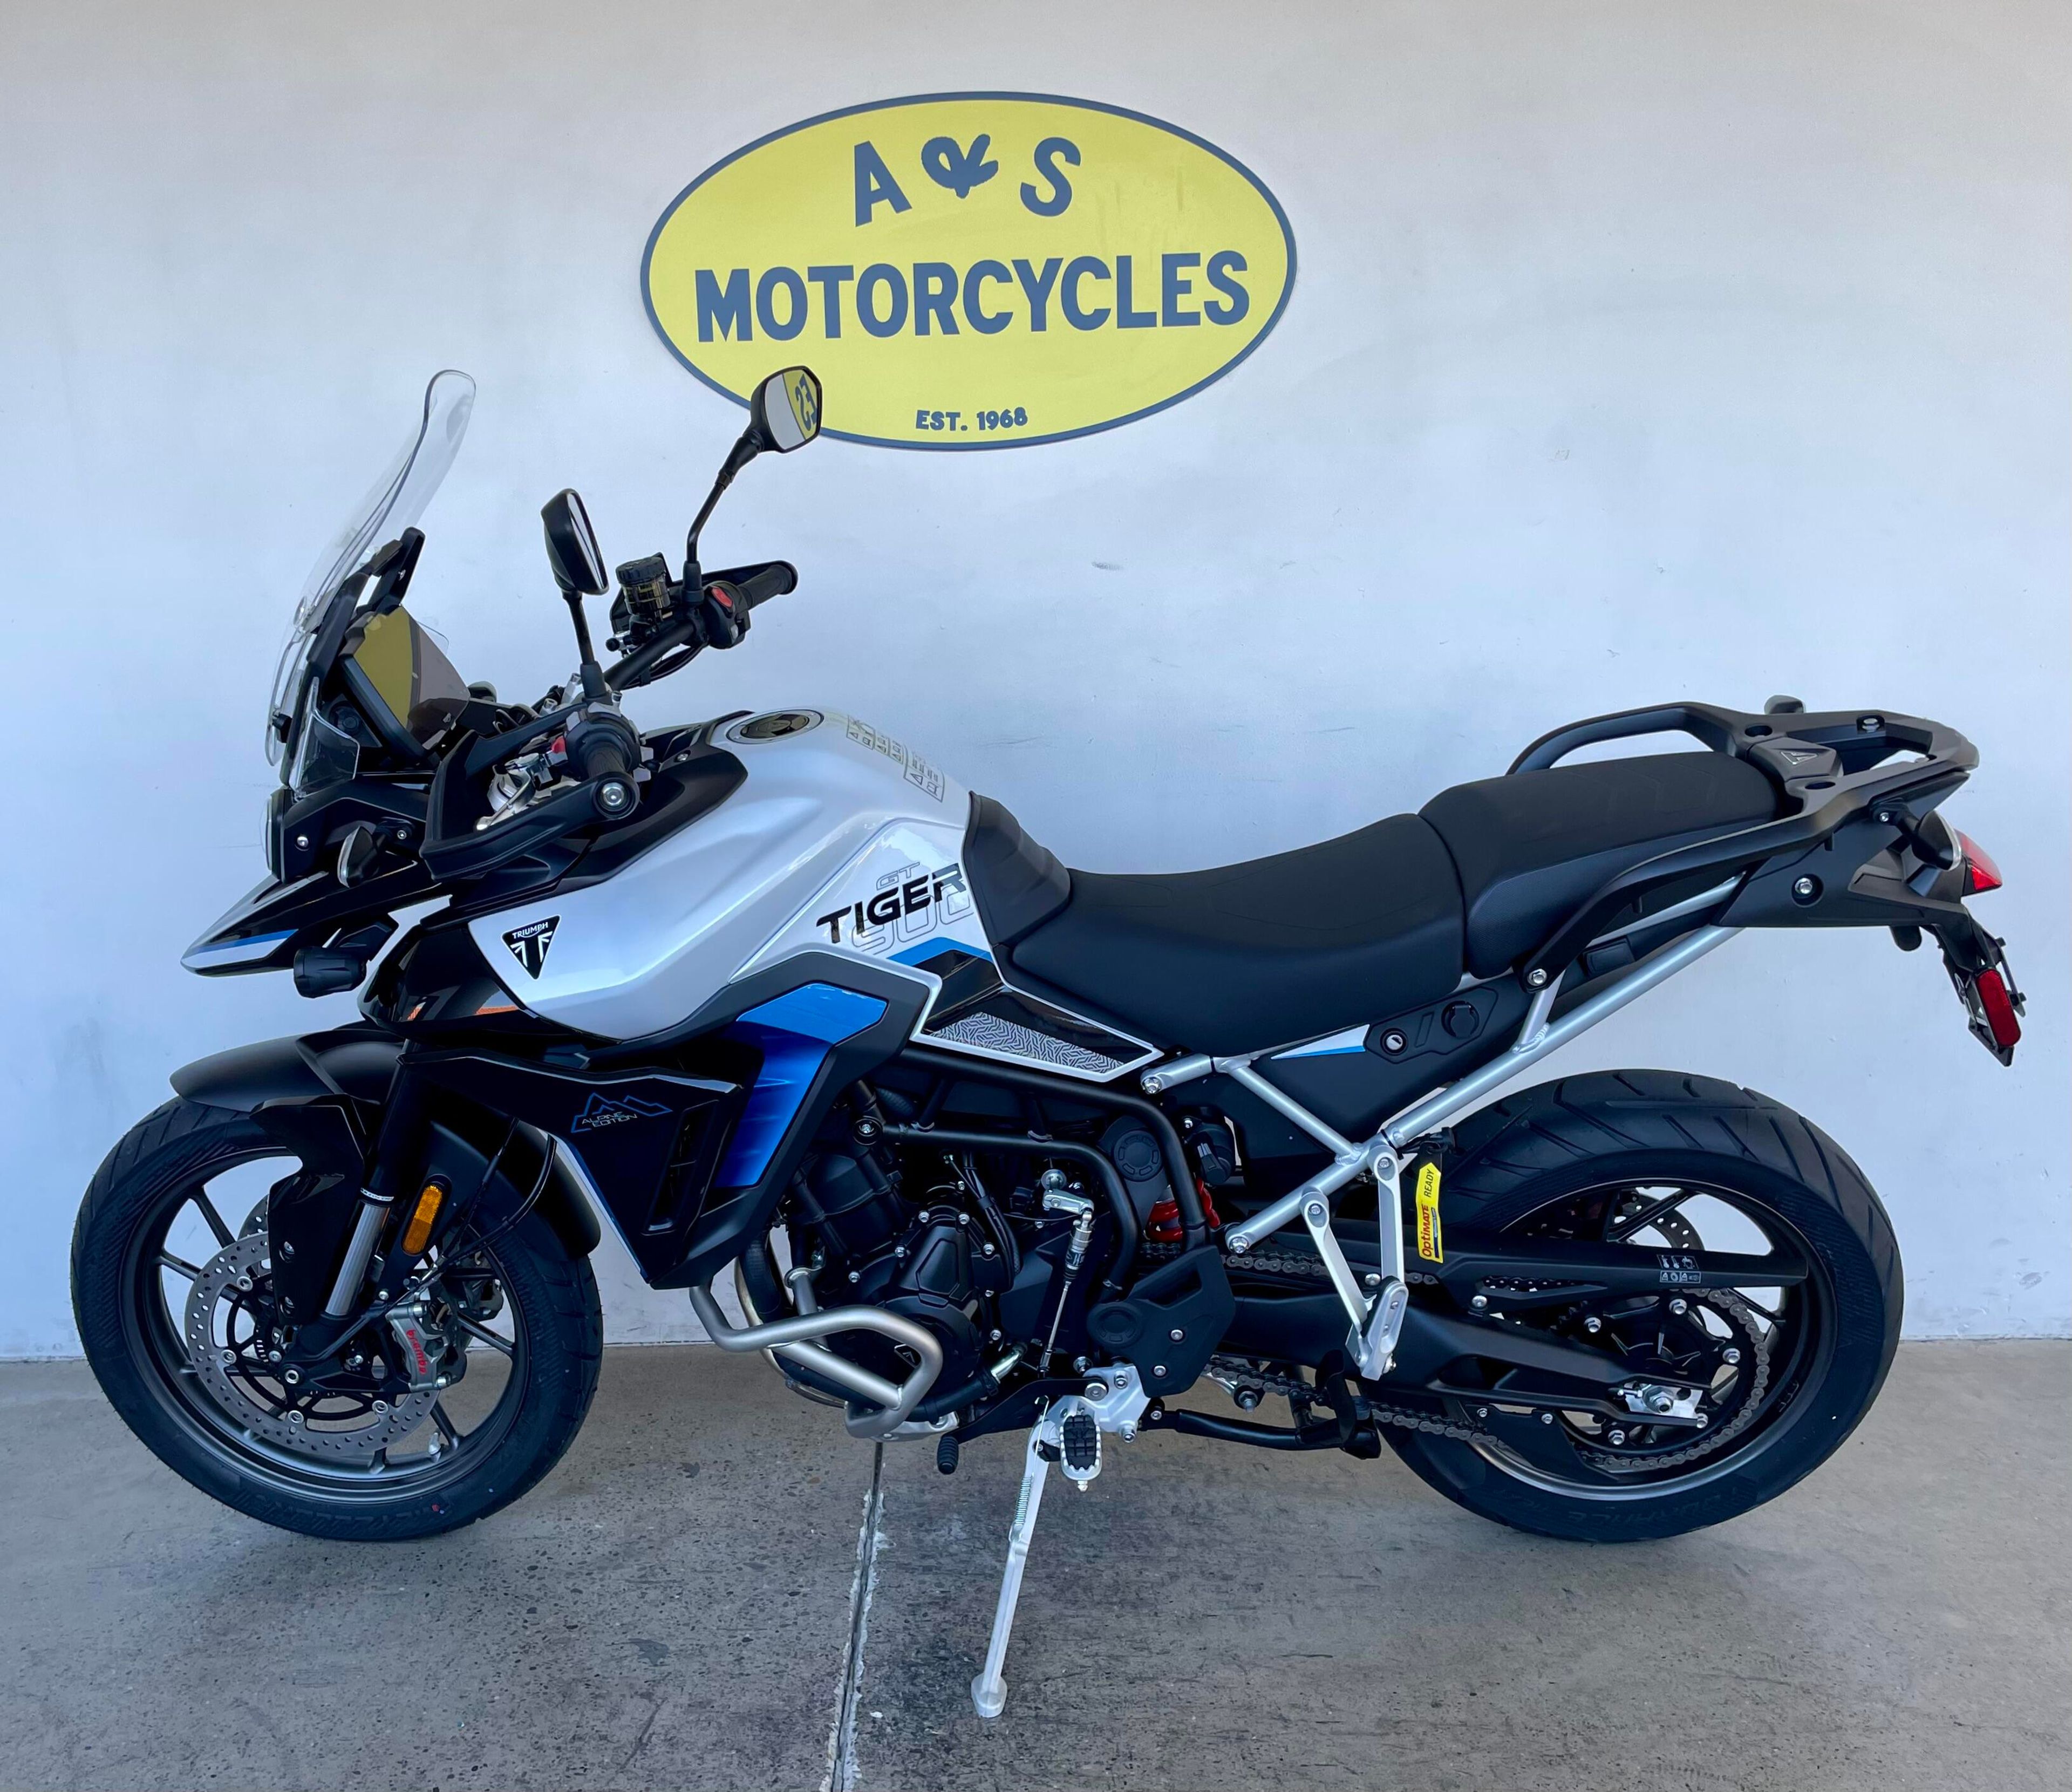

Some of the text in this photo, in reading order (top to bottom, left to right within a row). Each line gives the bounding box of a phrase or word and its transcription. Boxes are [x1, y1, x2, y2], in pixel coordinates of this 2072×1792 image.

[854, 142, 911, 226] A
[1020, 137, 1080, 217] S
[695, 250, 1250, 343] MOTORCYCLES
[916, 406, 1028, 431] EST. 1968
[876, 861, 921, 891] GT
[815, 862, 967, 944] TIGER
[512, 921, 549, 939] TRIUMPH
[582, 1111, 623, 1125] ALPINE
[592, 1113, 638, 1127] EDITION
[1423, 1168, 1435, 1198] READY
[1421, 1203, 1434, 1257] OptiMATE
